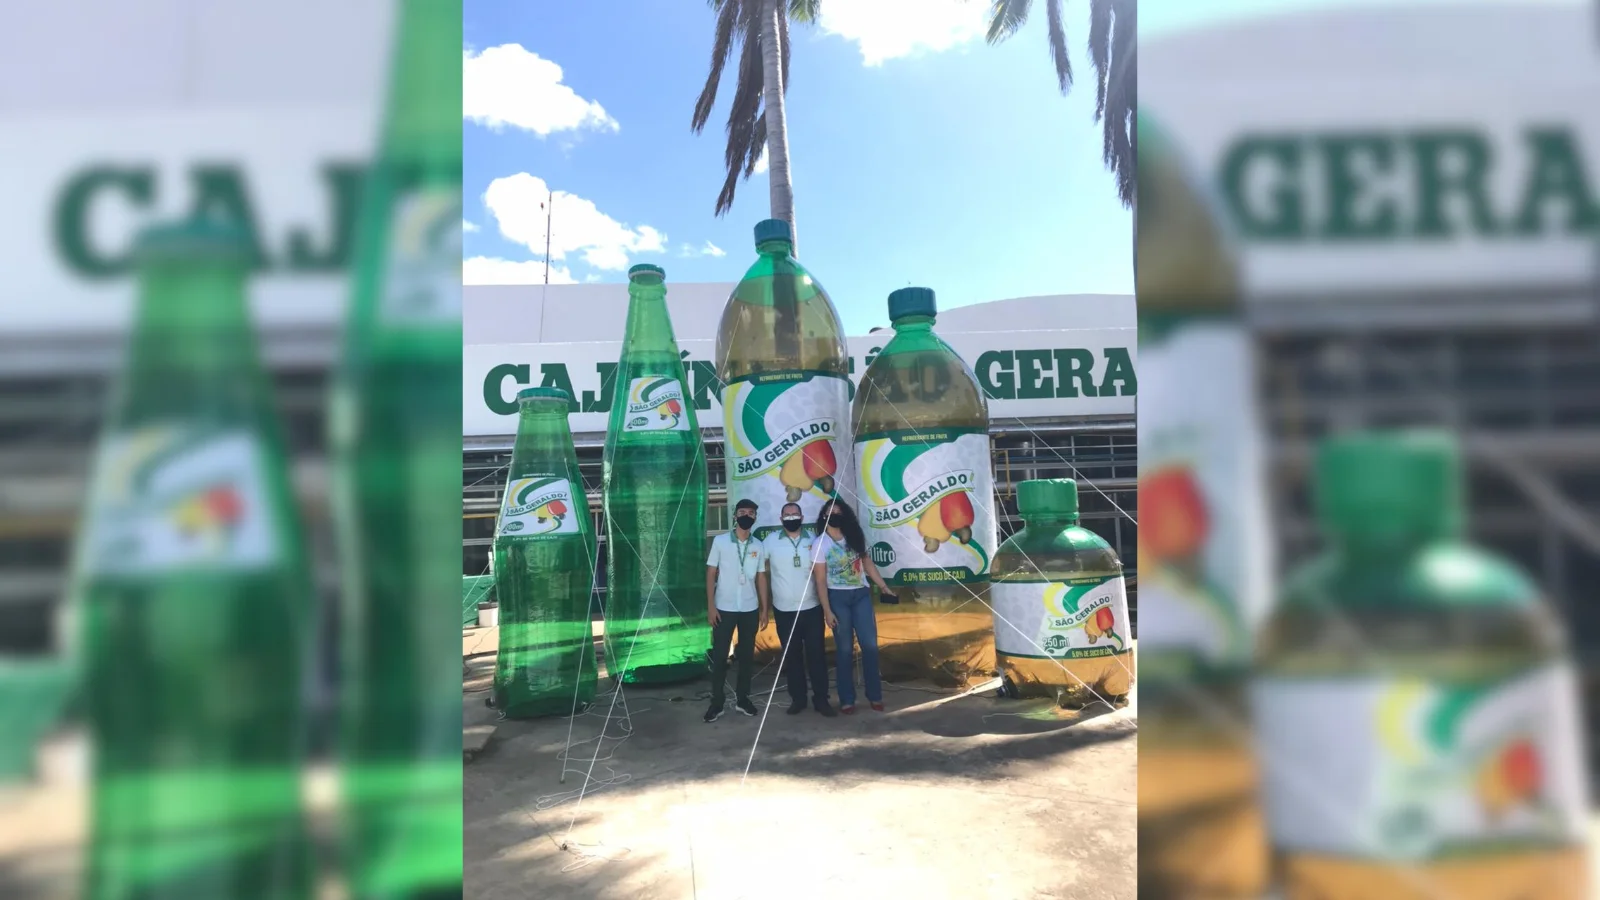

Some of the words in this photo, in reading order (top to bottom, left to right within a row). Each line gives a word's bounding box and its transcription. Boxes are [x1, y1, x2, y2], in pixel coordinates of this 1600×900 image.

[738, 458, 762, 473] SÃO
[764, 421, 830, 462] GERALDO
[510, 507, 525, 515] SÃO
[526, 493, 563, 510] GERALDO
[875, 508, 900, 522] SÃO
[902, 473, 967, 514] GERALDO
[873, 546, 896, 563] litro
[903, 572, 918, 582] 5.0%
[919, 572, 926, 581] DE
[927, 571, 942, 581] SUCO
[952, 570, 966, 580] CAJU
[1055, 617, 1074, 627] SÃO
[1075, 596, 1110, 621] GERALDO
[1042, 636, 1059, 647] 250
